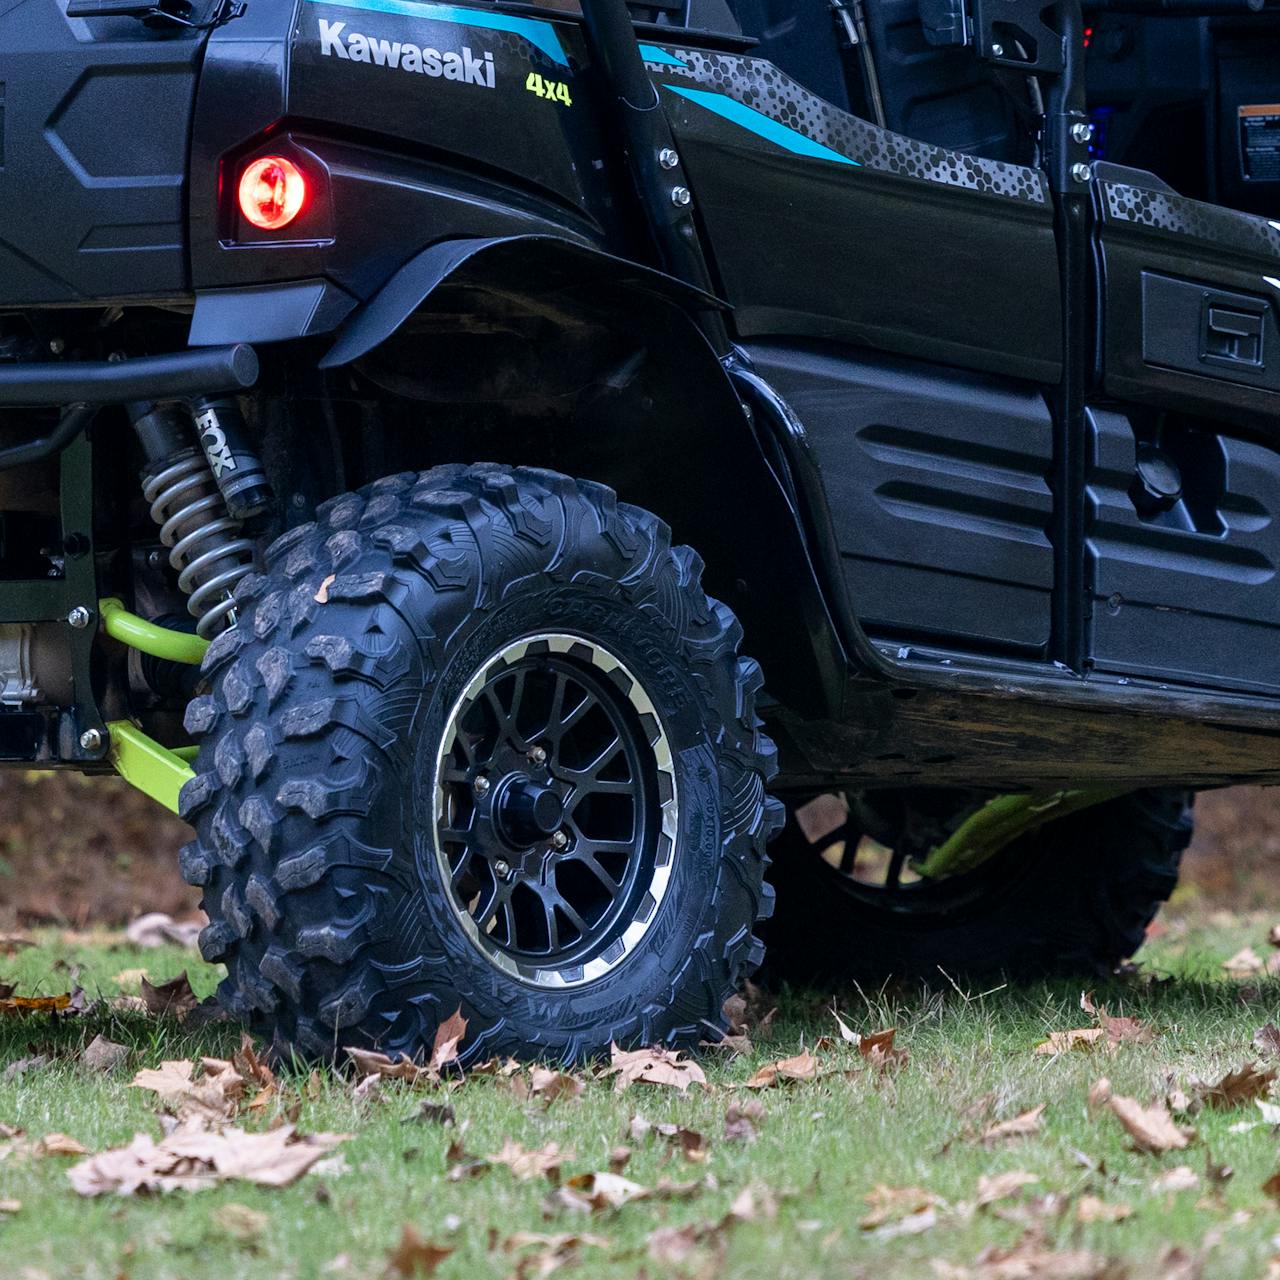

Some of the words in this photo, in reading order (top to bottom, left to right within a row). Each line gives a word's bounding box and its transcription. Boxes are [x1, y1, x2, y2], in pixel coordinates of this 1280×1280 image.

[318, 18, 496, 89] Kawasaki
[525, 72, 573, 107] 4x4
[194, 408, 238, 478] FOX
